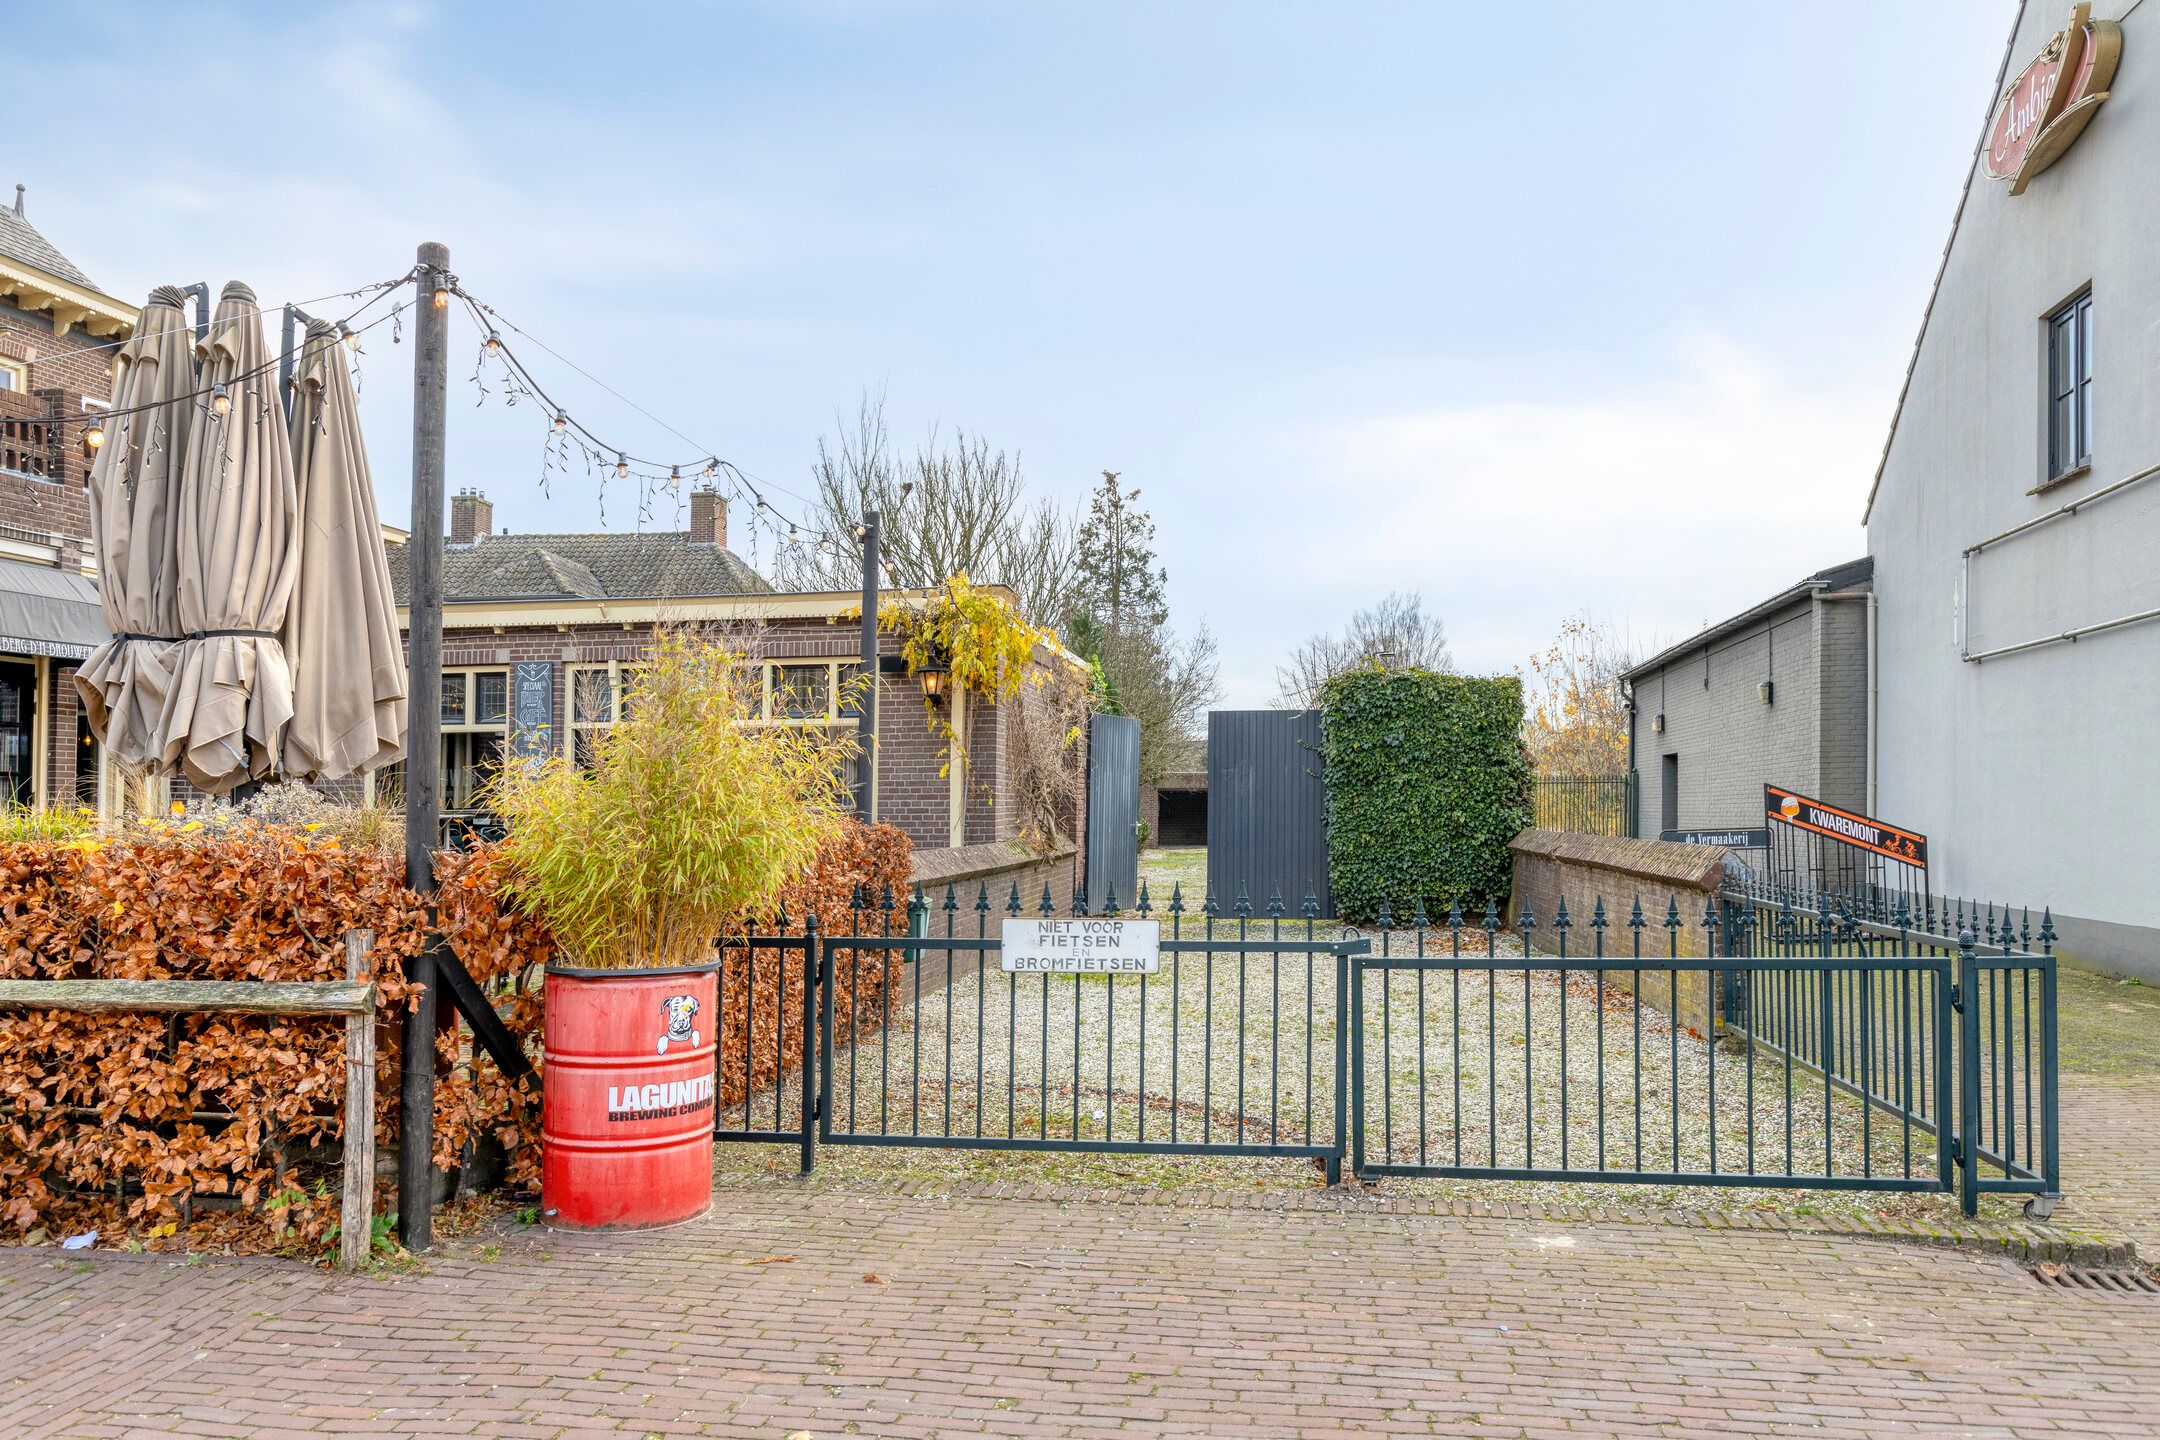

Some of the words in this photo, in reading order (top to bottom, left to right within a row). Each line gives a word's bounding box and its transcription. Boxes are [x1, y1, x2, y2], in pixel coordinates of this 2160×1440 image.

[0, 636, 27, 654] BERG
[30, 640, 47, 656] D'N
[1808, 807, 1882, 846] KWAREMONT
[1685, 833, 1695, 845] de
[1697, 832, 1749, 846] Vermaakerij
[1038, 921, 1073, 934] NIET
[1082, 921, 1124, 934] VOOR
[1039, 935, 1120, 948] FIETSEN
[1072, 948, 1090, 957] EN
[1015, 957, 1146, 970] BROMFIETSEN
[608, 1107, 677, 1122] BREWING
